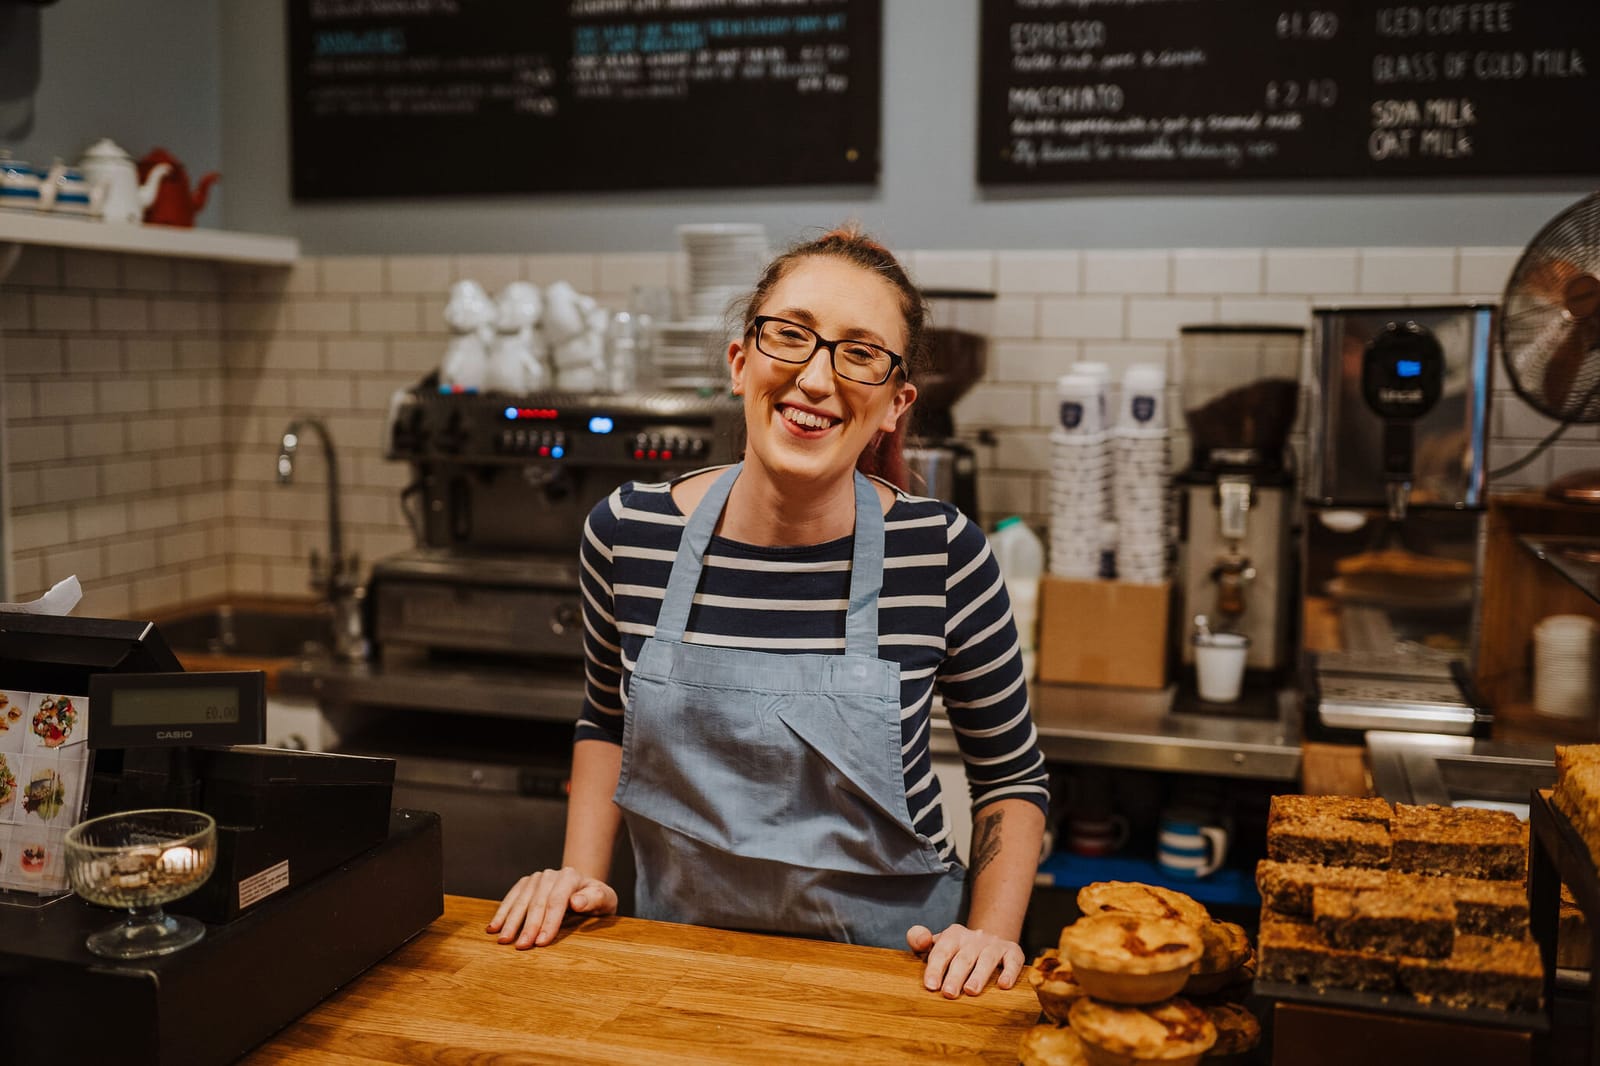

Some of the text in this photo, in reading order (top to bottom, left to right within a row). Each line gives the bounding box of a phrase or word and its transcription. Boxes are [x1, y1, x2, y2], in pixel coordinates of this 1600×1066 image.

[1424, 2, 1515, 36] COFFEE
[1531, 48, 1587, 78] MILK
[1424, 98, 1477, 128] MILK
[1368, 128, 1474, 160] OAT MILK
[156, 731, 193, 739] CASIO
